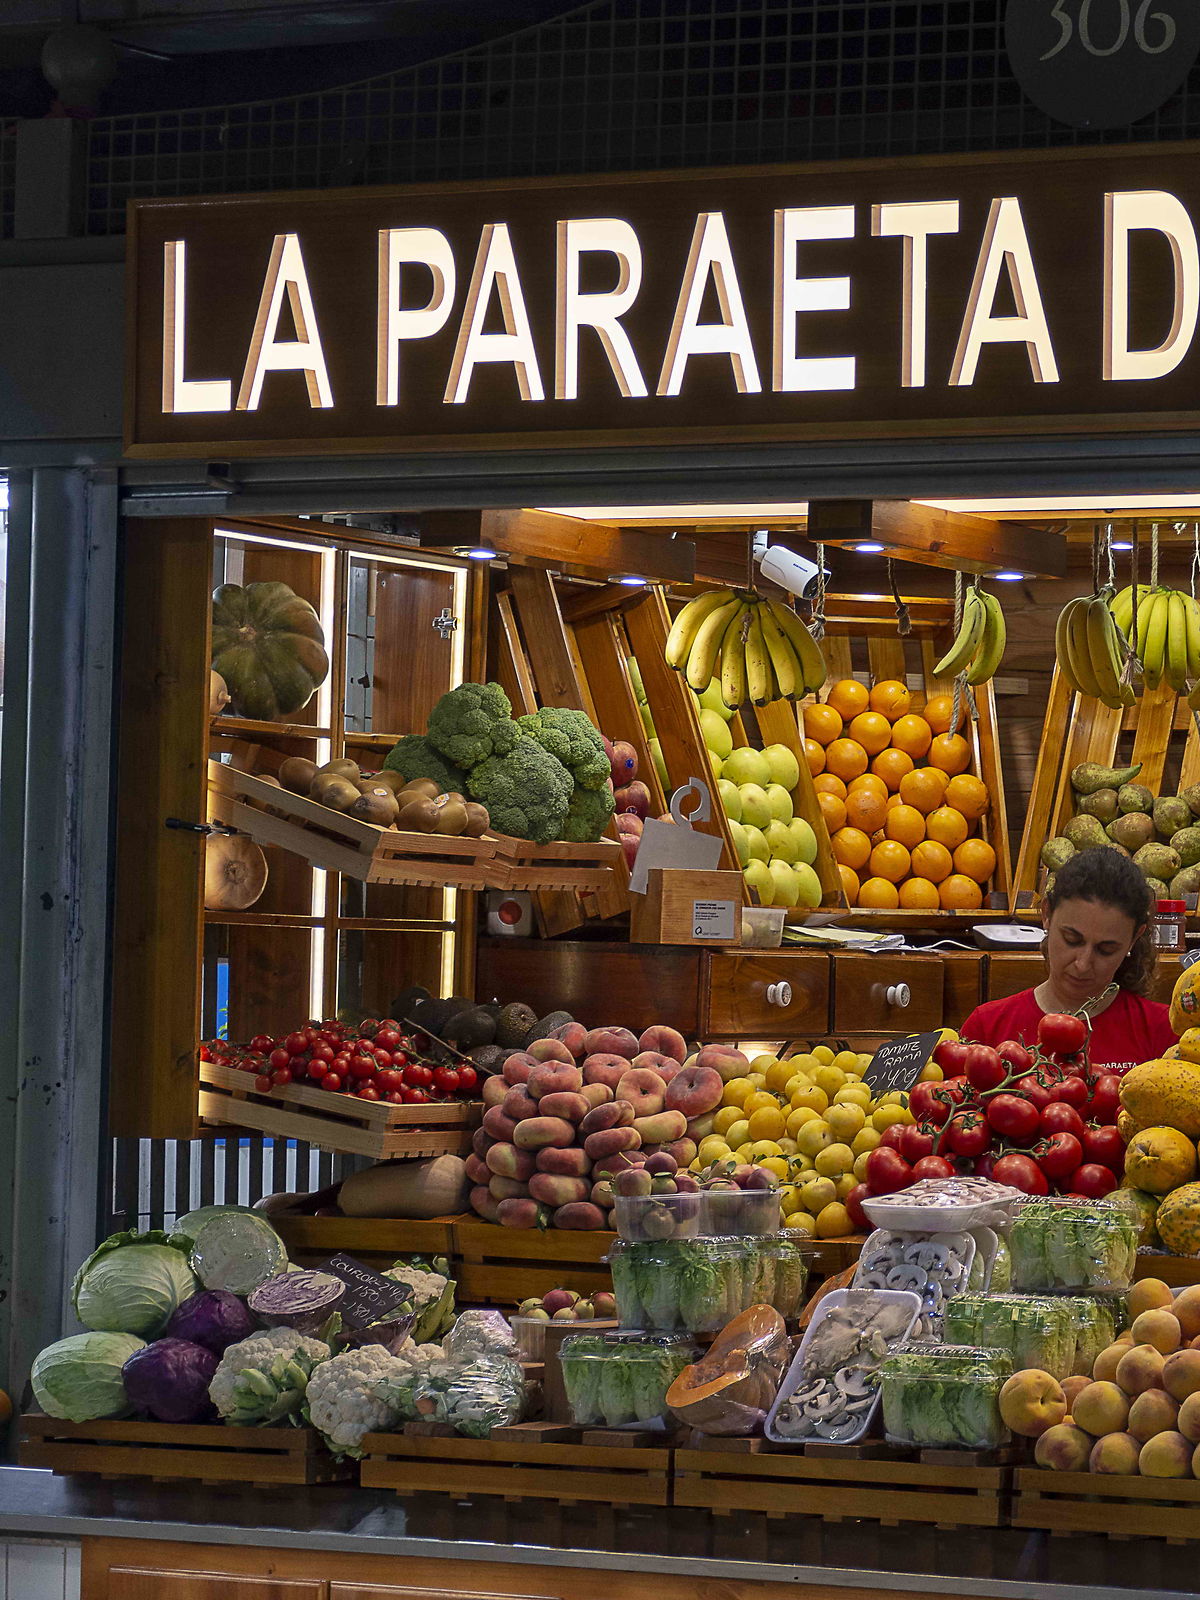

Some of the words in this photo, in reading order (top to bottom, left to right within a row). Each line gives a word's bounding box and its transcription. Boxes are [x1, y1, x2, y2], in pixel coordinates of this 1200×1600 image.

[1040, 0, 1177, 61] 306
[161, 232, 334, 414] LA
[376, 196, 1060, 407] PARAETA
[878, 1041, 920, 1059] TOMATE
[883, 1050, 922, 1068] RAMA
